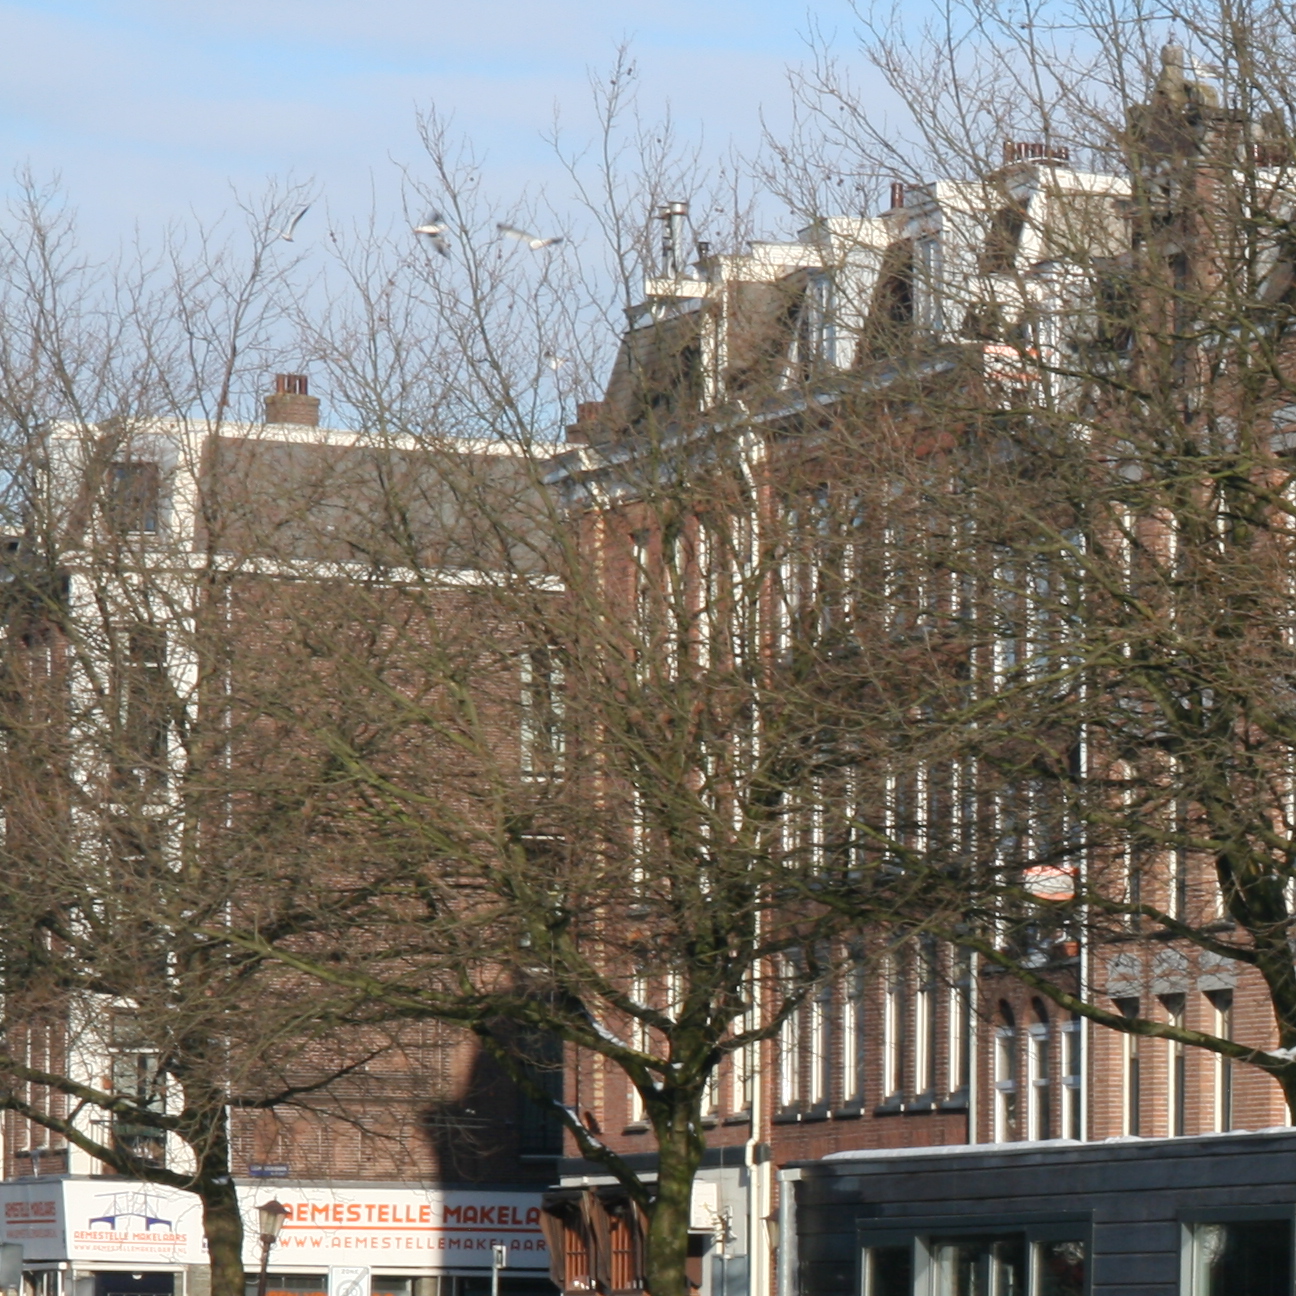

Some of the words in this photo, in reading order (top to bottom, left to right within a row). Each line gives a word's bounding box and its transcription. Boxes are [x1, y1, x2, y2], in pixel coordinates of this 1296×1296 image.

[281, 1202, 431, 1224] AEMESTELLE
[73, 1230, 129, 1241] AEMESTELLE
[132, 1232, 188, 1243] MAKELAARS
